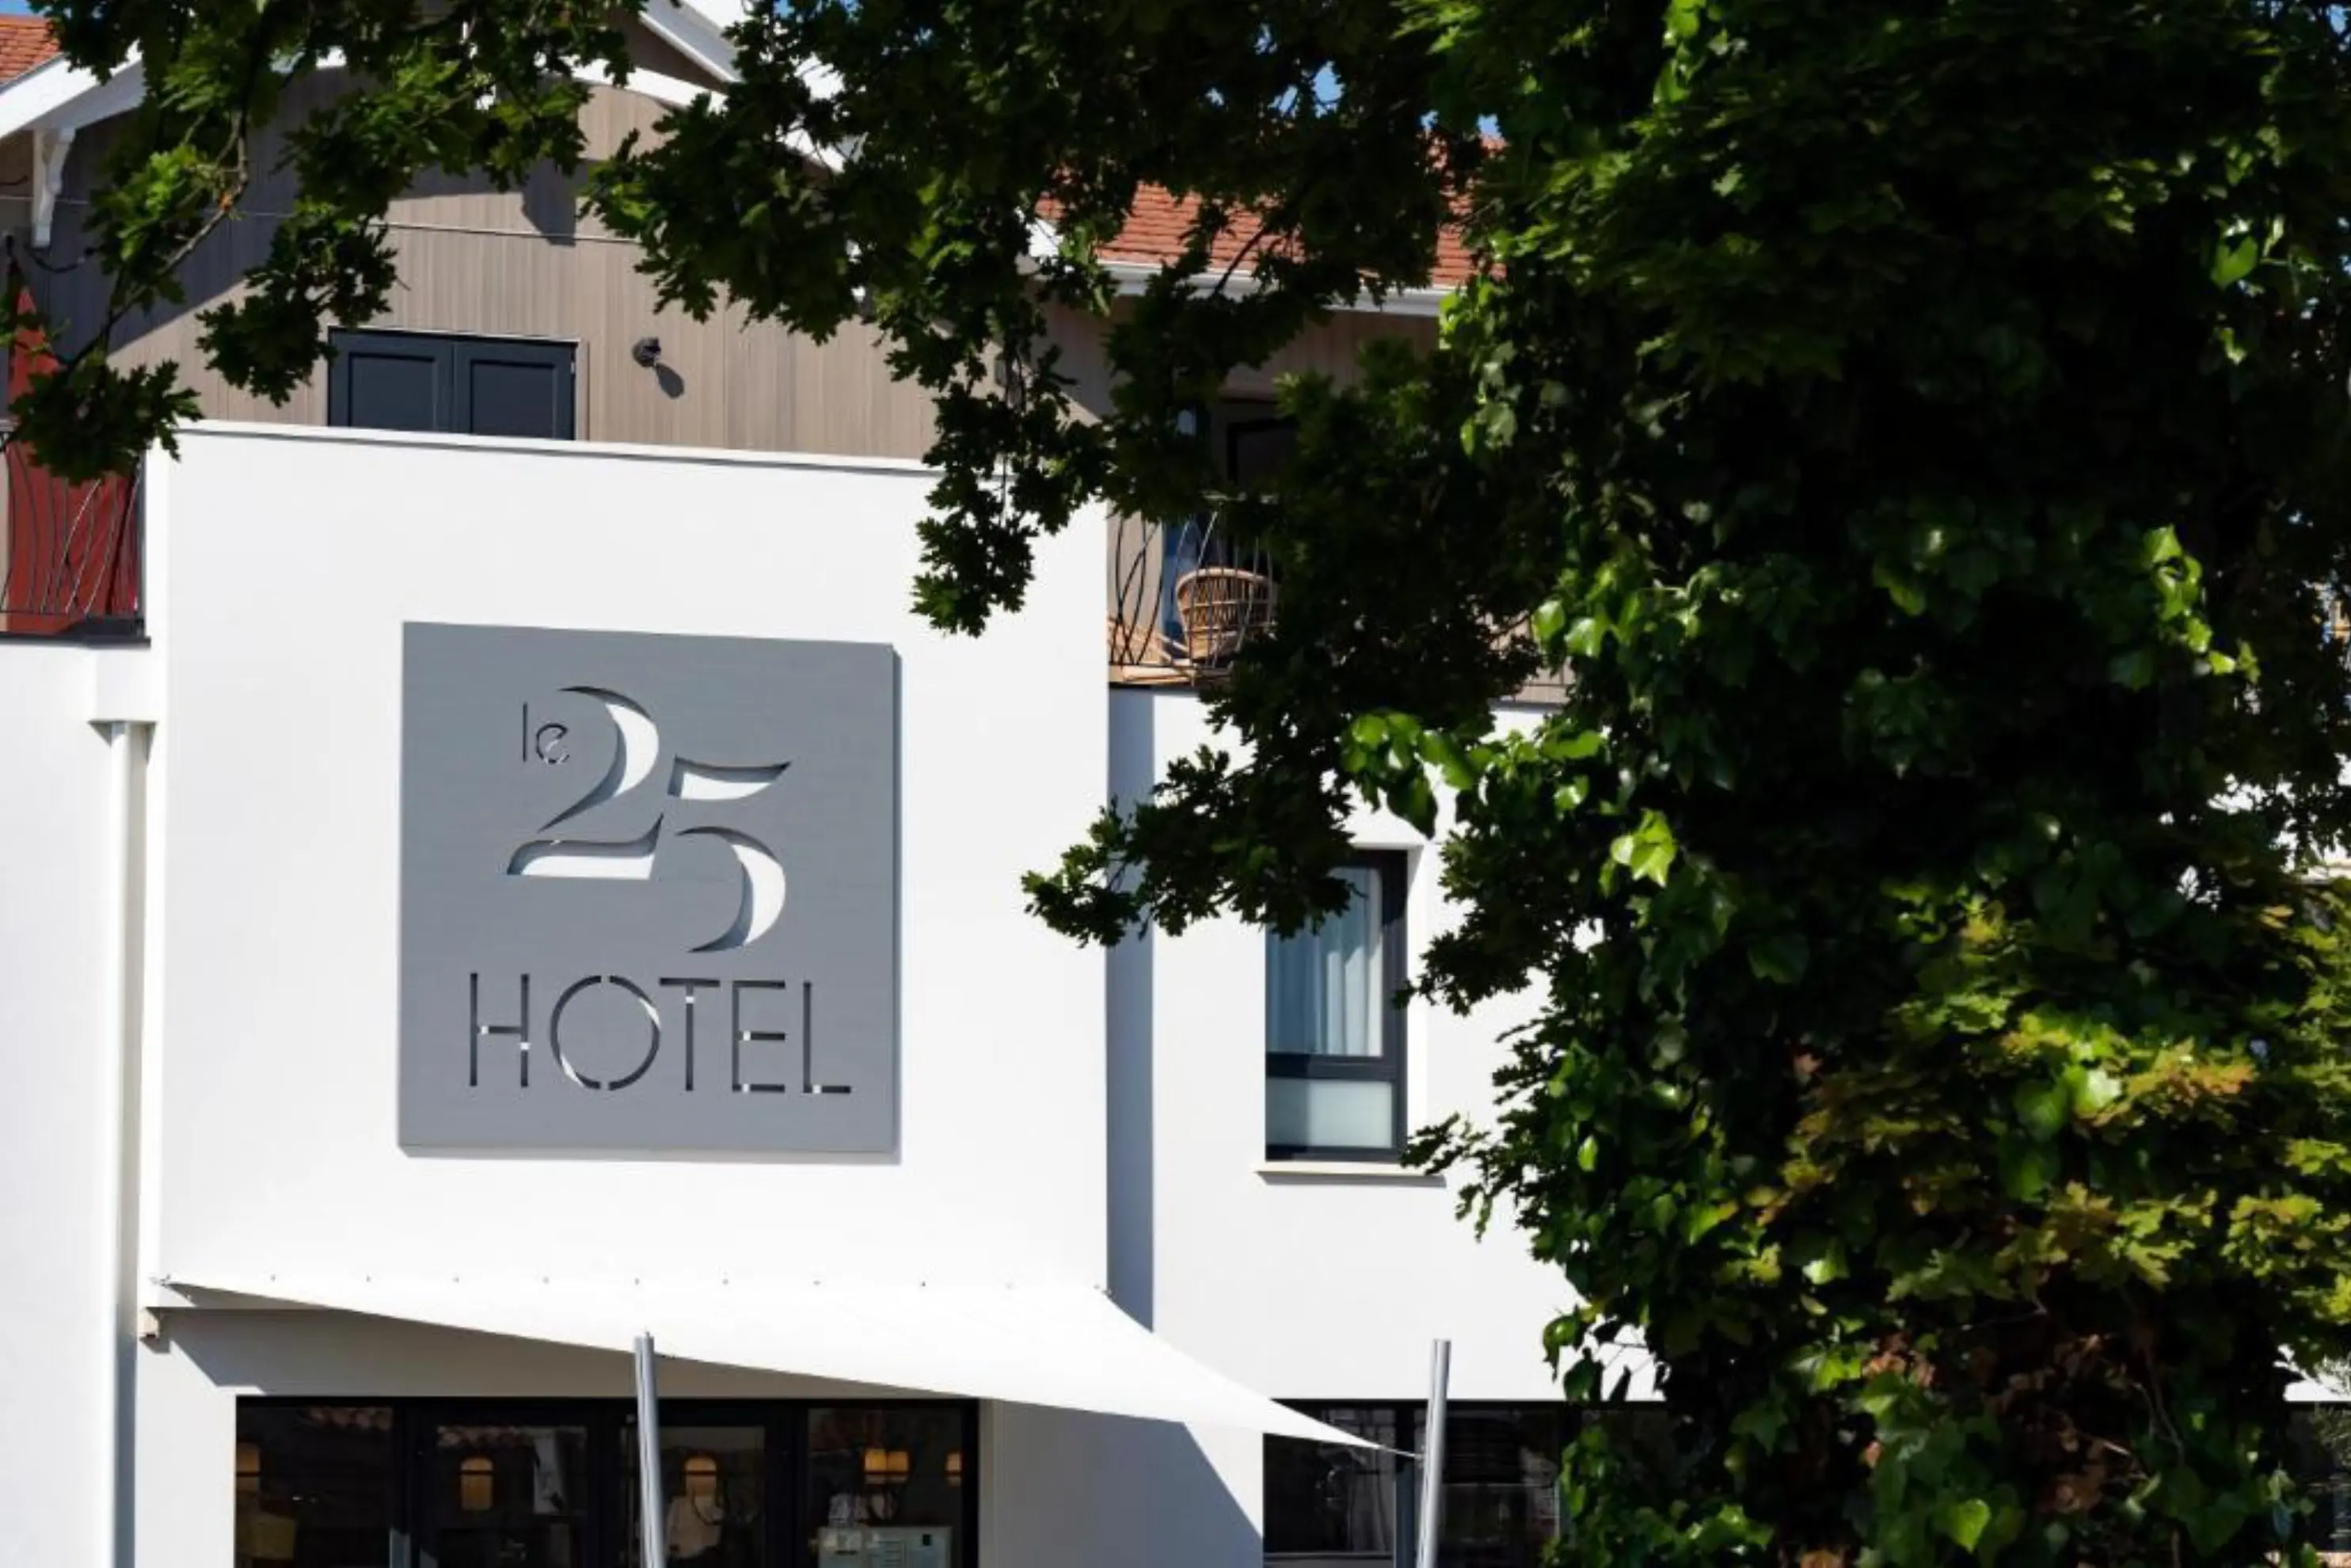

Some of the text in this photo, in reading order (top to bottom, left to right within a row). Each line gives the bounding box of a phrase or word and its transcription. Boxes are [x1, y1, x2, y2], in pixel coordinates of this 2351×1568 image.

[507, 685, 792, 953] le 25
[470, 972, 852, 1094] HOTEL
